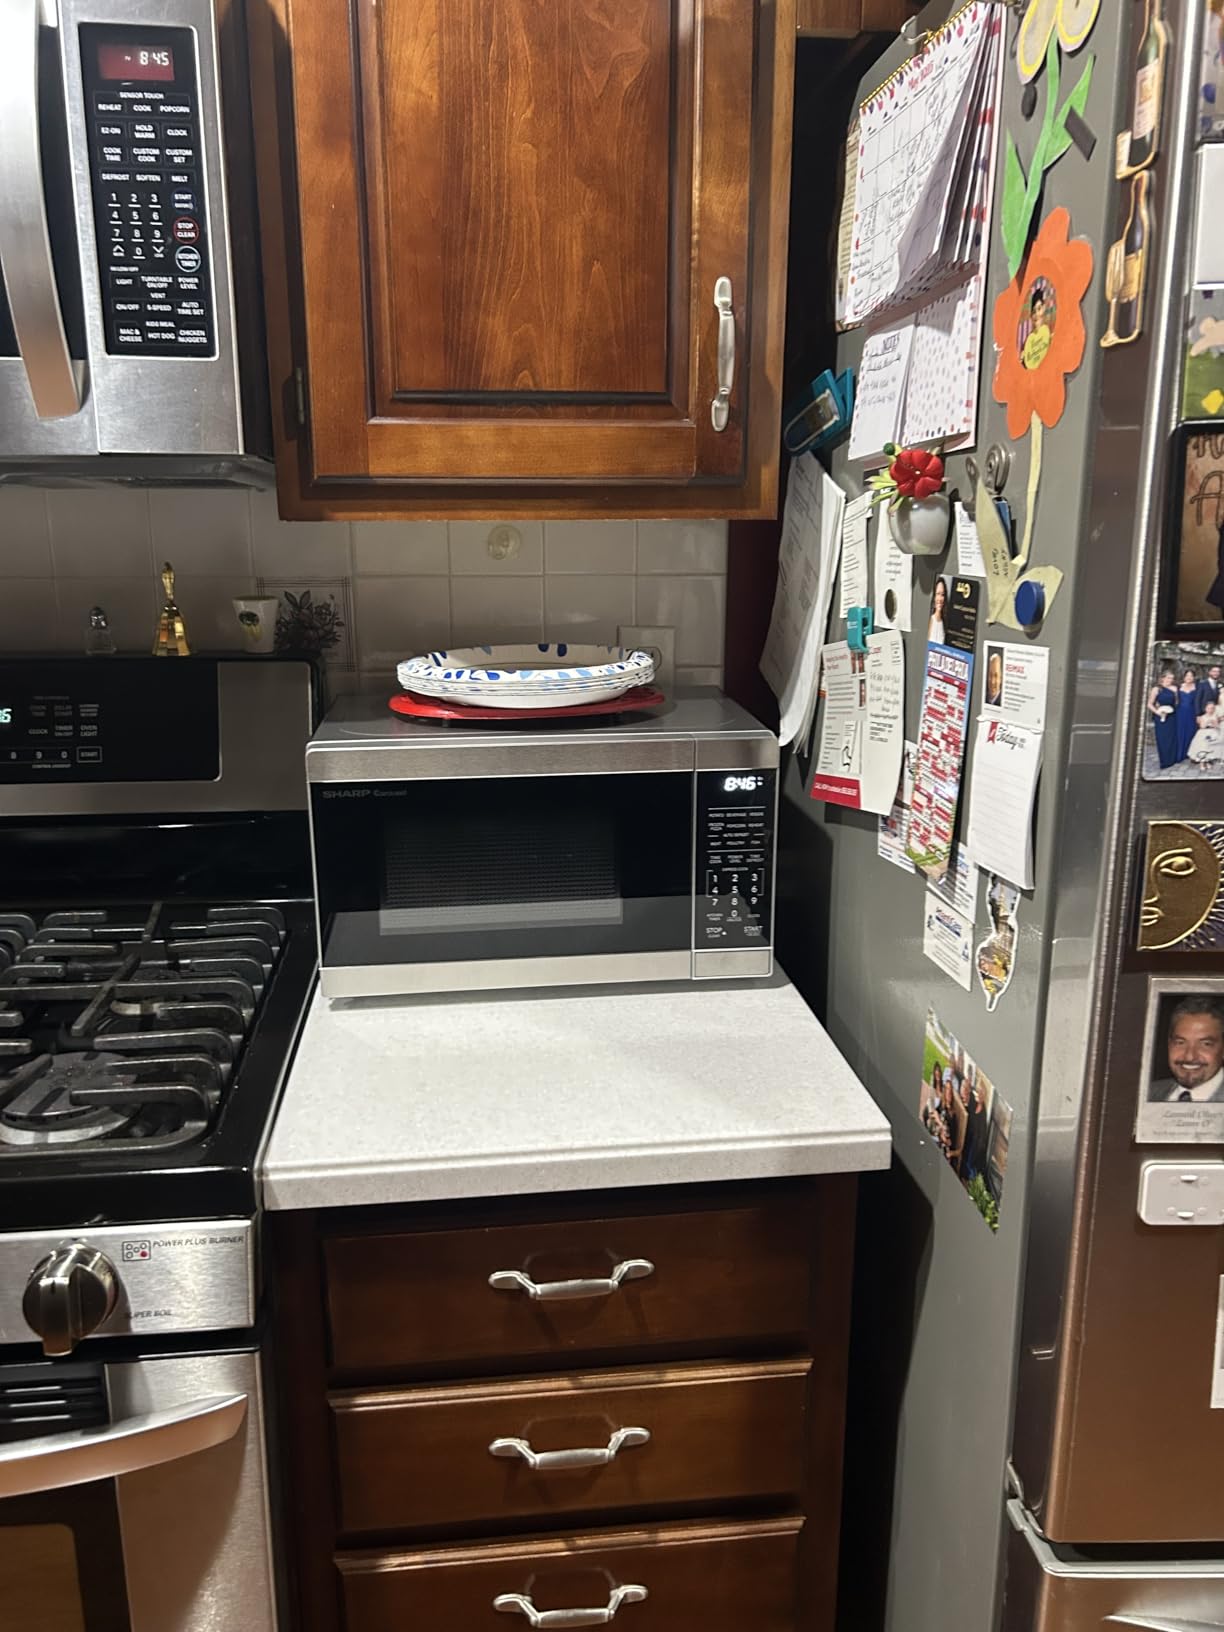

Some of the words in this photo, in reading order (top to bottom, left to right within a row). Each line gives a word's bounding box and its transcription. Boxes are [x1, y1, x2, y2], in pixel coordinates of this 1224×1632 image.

[133, 104, 152, 112] COOK
[111, 193, 117, 202] 1
[130, 193, 137, 202] 2
[151, 194, 158, 202] 3
[112, 211, 119, 219] 4
[132, 211, 139, 220] 5
[152, 211, 160, 220] 6
[113, 228, 120, 237] 7
[134, 229, 141, 238] 8
[154, 229, 161, 238] 9
[135, 247, 142, 255] 0
[322, 789, 370, 799] SHARP
[713, 874, 718, 882] 1
[731, 874, 738, 882] 2
[751, 873, 758, 881] 3
[712, 886, 718, 894] 4
[731, 885, 738, 893] 5
[751, 885, 758, 893] 6
[712, 898, 718, 906] 7
[731, 898, 738, 906] 8
[153, 1240, 183, 1248] POWER
[185, 1238, 207, 1246] PLUS
